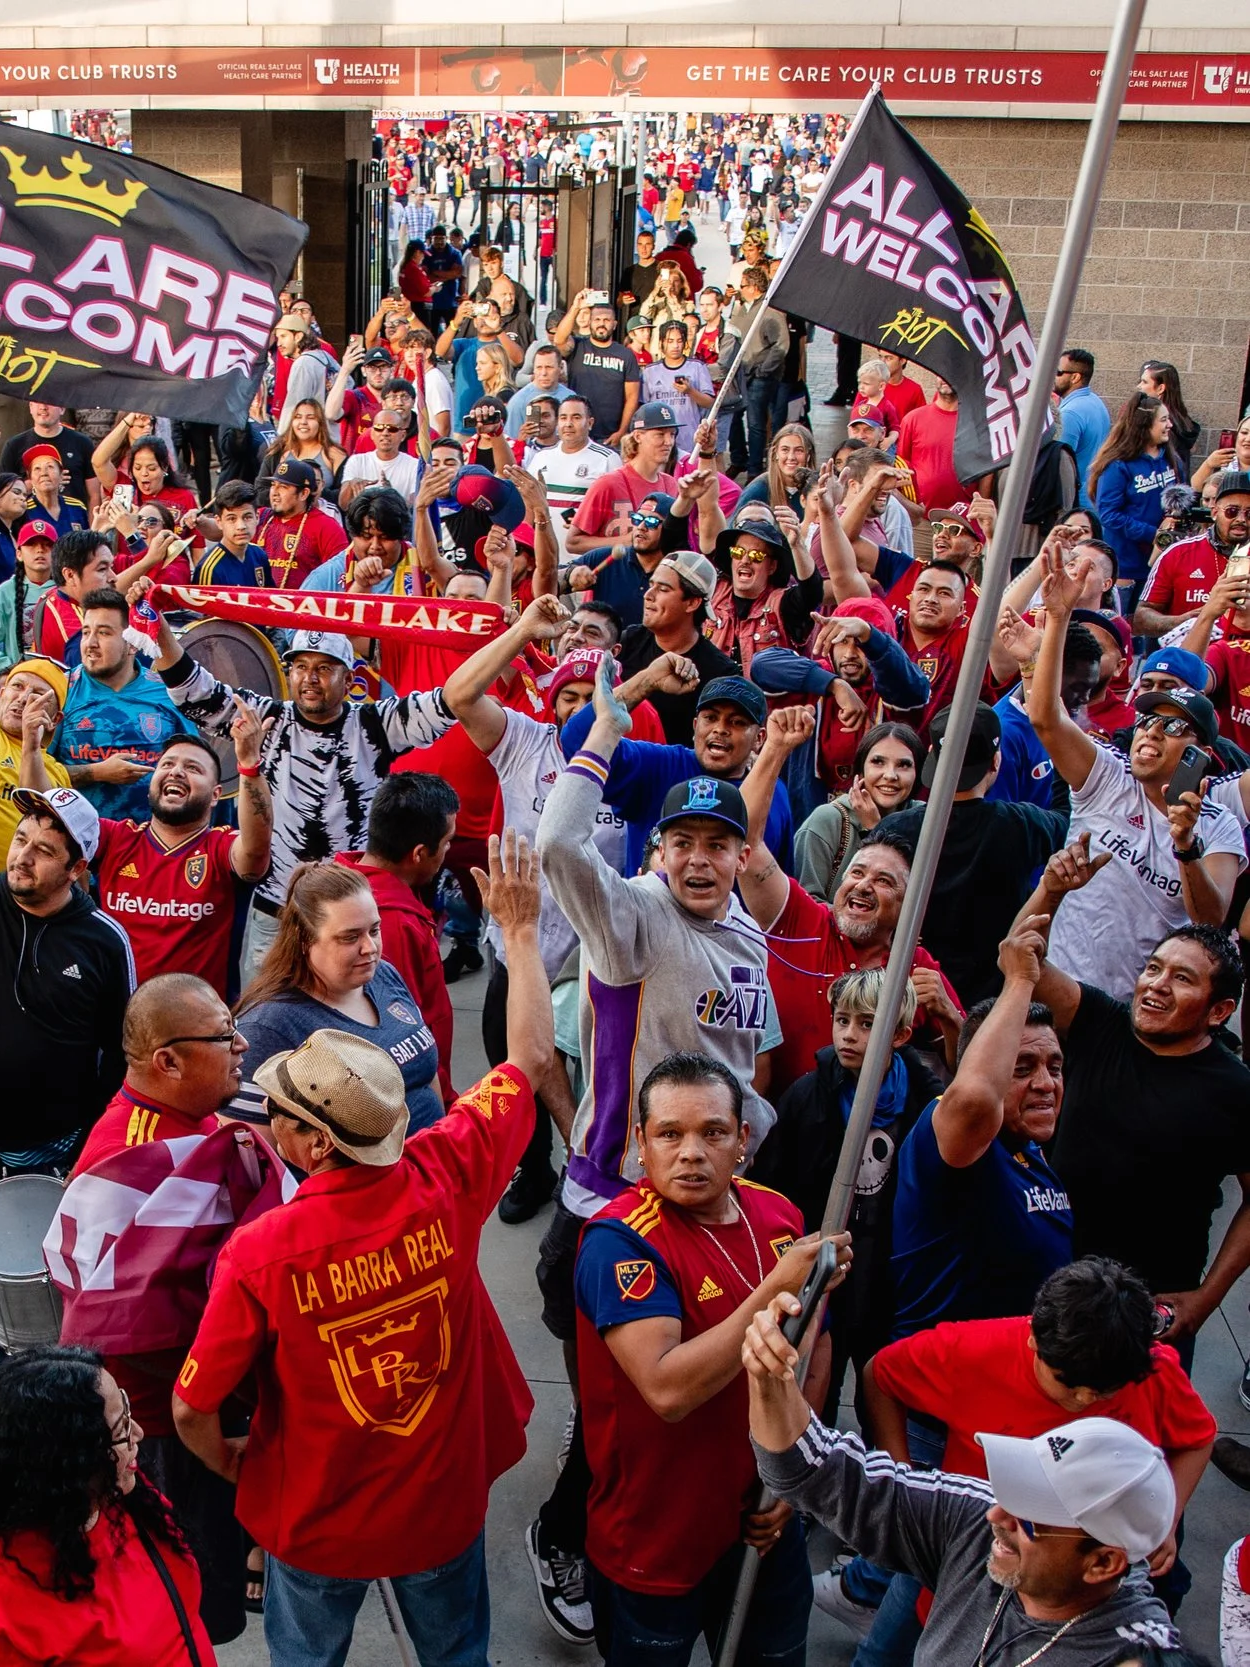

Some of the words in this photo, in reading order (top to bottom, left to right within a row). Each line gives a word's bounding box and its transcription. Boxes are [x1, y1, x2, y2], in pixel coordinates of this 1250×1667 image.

[1, 65, 50, 81] YOUR
[57, 65, 104, 80] CLUB
[110, 64, 177, 80] TRUSTS
[217, 63, 248, 71] OFFICIAL
[251, 63, 267, 71] REAL
[268, 63, 284, 71] SALT
[285, 63, 302, 71] LAKE
[224, 72, 250, 80] HEALTH
[251, 72, 269, 80] CARE
[270, 72, 302, 80] PARTNER
[344, 63, 400, 77] HEALTH
[687, 66, 725, 82] GET
[733, 66, 770, 81] THE
[778, 66, 831, 82] CARE
[838, 66, 895, 83] YOUR
[903, 67, 956, 84] CLUB
[965, 68, 1043, 85] TRUSTS
[1128, 70, 1148, 78] REAL
[1149, 71, 1168, 79] SALT
[1169, 71, 1188, 79] LAKE
[1128, 80, 1149, 88] CARE
[1152, 81, 1188, 89] PARTNER
[831, 162, 959, 265] ALL
[54, 235, 278, 349] ARE
[821, 209, 1018, 463] WELCOME
[878, 308, 970, 356] RIOT
[583, 352, 602, 367] OLD
[602, 354, 625, 372] NAVY
[268, 593, 375, 625] SALT
[381, 600, 498, 636] LAKE
[106, 891, 214, 921] LifeVantage
[389, 1037, 418, 1065] SALT
[1024, 1186, 1071, 1213] LifeVan
[291, 1272, 325, 1314] LA
[327, 1245, 404, 1306] BARRA
[405, 1219, 455, 1276] REAL
[619, 1265, 640, 1276] MLS
[697, 1288, 724, 1302] adidas
